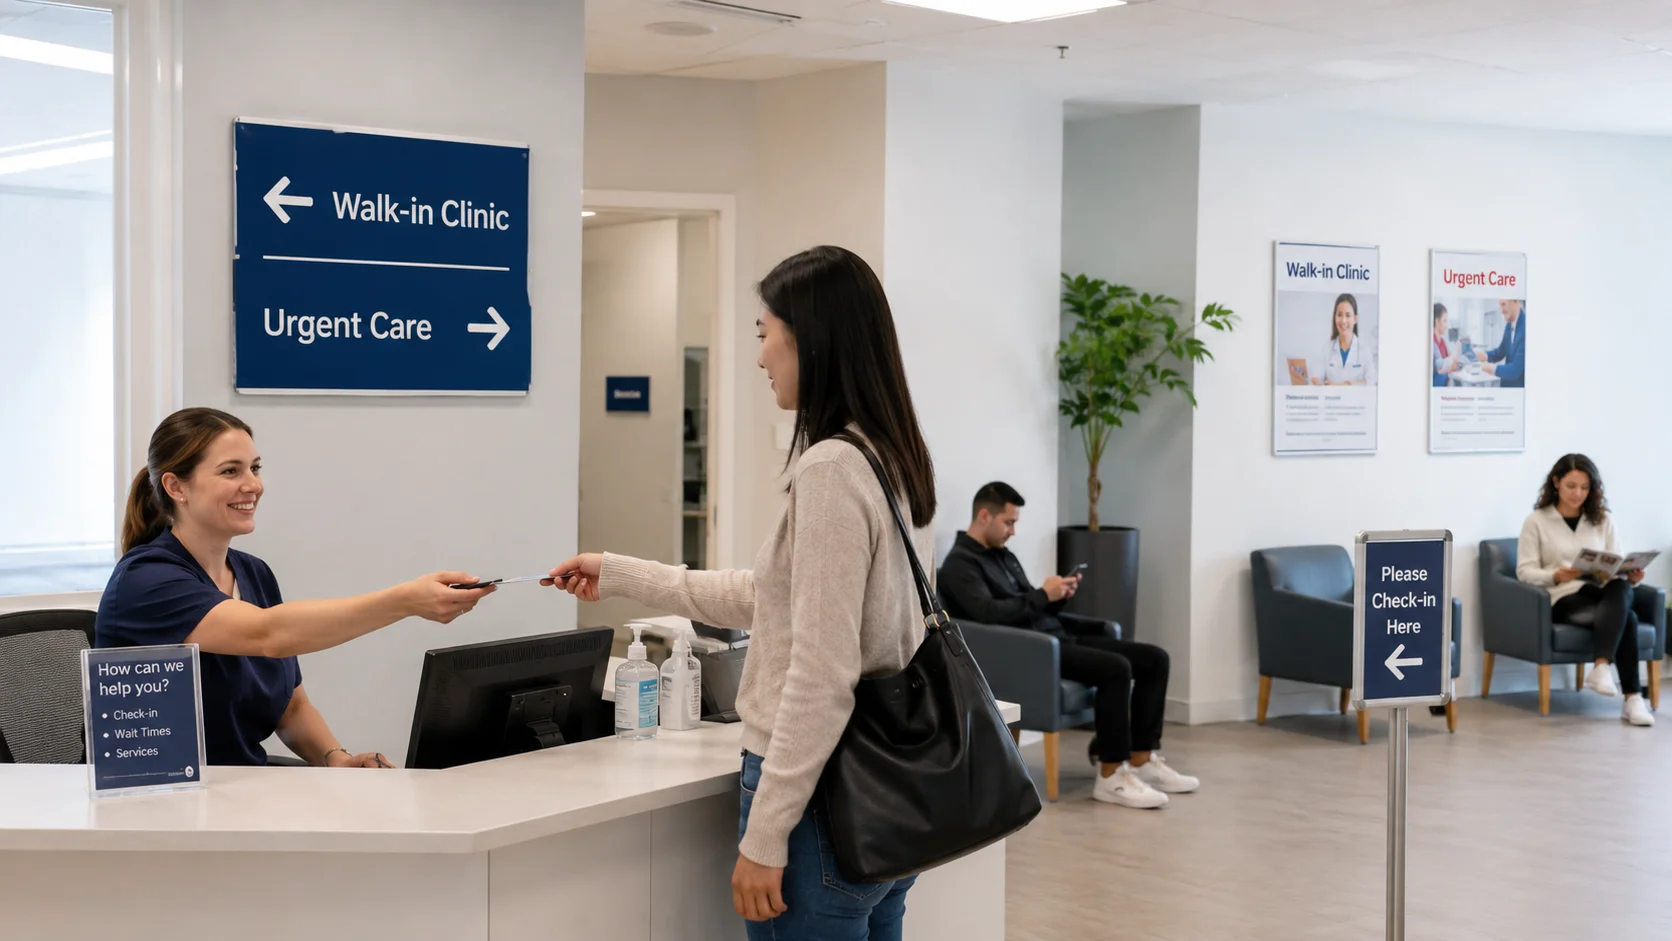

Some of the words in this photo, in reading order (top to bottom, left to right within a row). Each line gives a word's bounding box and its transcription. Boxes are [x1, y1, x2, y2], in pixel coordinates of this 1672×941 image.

[332, 191, 434, 225] Walk-in
[441, 200, 510, 231] Clinic
[1286, 261, 1334, 279] Walk-in
[1336, 264, 1370, 281] Clinic
[1443, 268, 1486, 289] Urgent
[1488, 271, 1516, 287] Care
[263, 307, 362, 345] Urgent
[370, 311, 432, 341] Care
[1381, 565, 1428, 582] Please
[1371, 591, 1436, 609] Check-in
[1386, 618, 1421, 635] Here
[98, 663, 130, 677] How
[134, 662, 160, 675] can
[163, 661, 184, 672] we
[99, 681, 131, 698] help
[134, 678, 170, 697] you?
[113, 708, 158, 721] Check-in
[114, 728, 138, 739] Wait
[140, 726, 172, 738] Times
[116, 746, 159, 759] Services
